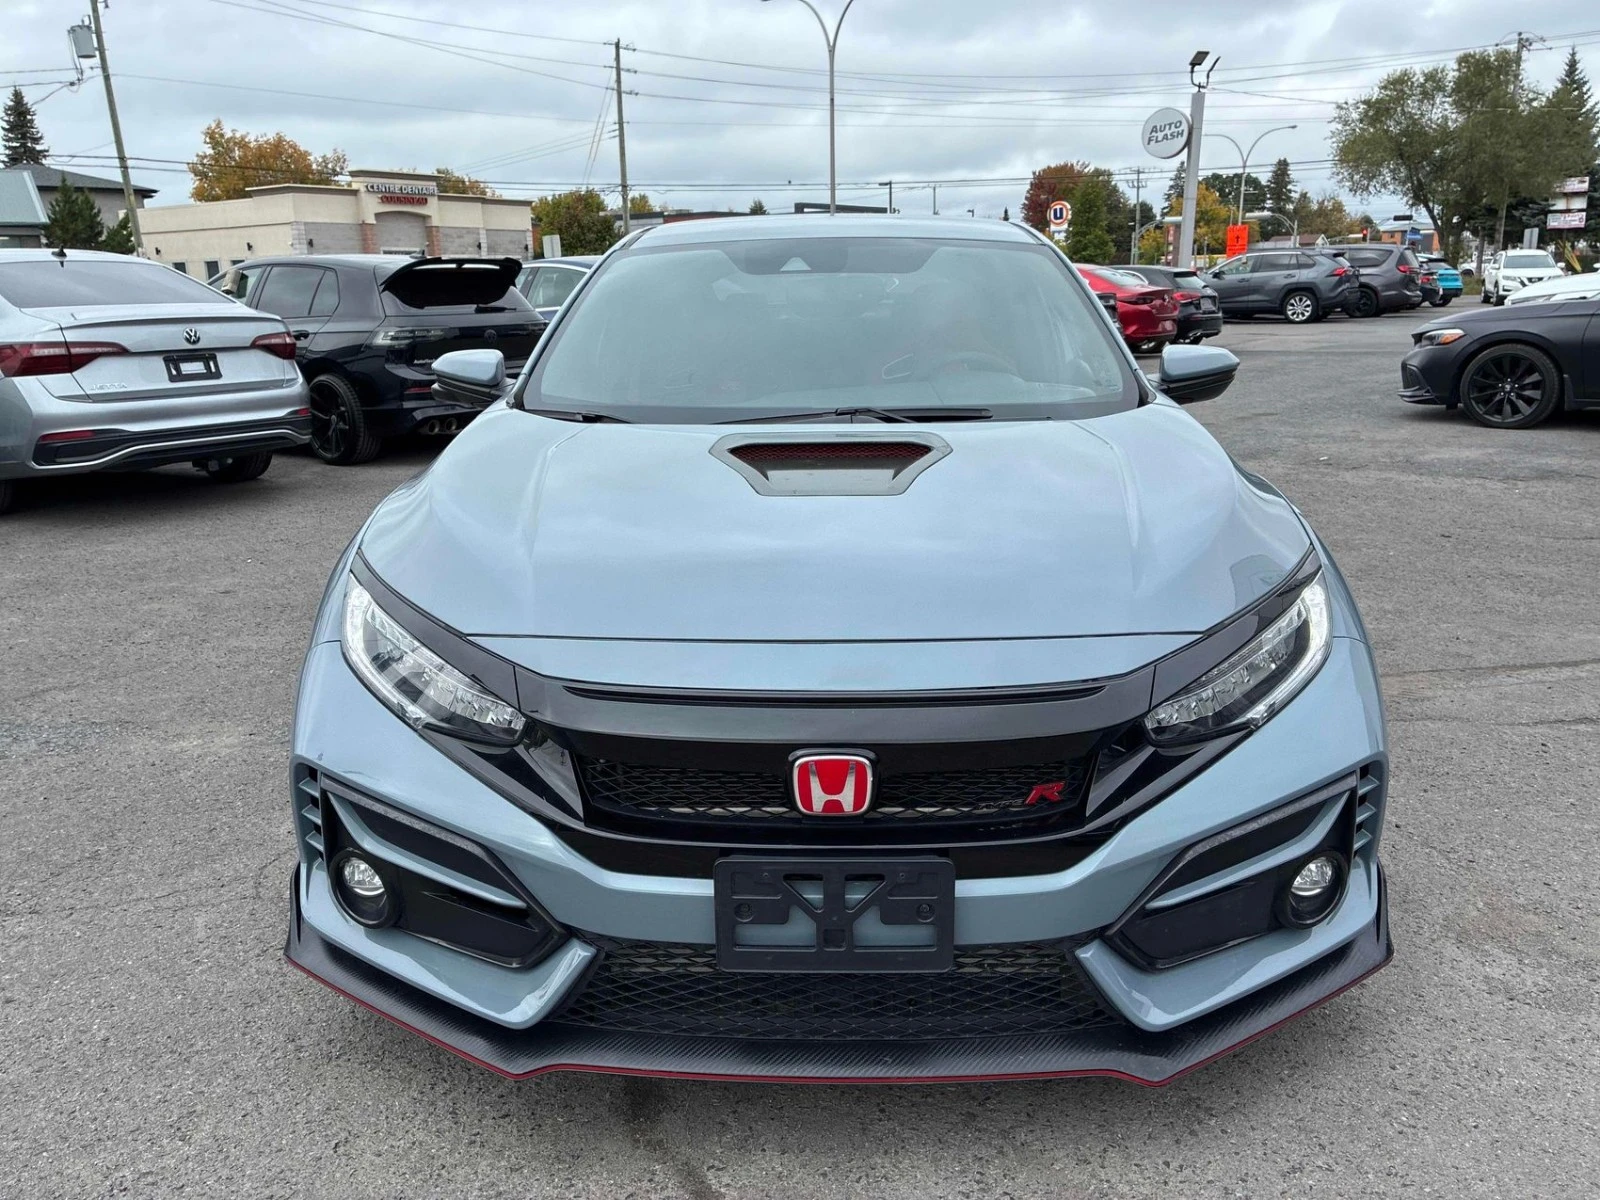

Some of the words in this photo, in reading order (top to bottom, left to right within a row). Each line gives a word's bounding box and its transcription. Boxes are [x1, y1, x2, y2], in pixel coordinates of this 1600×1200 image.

[1149, 120, 1182, 136] AUTO
[1147, 129, 1185, 146] FLASH
[368, 183, 402, 193] CENTRE
[90, 382, 128, 391] JETTA
[1023, 780, 1066, 805] R
